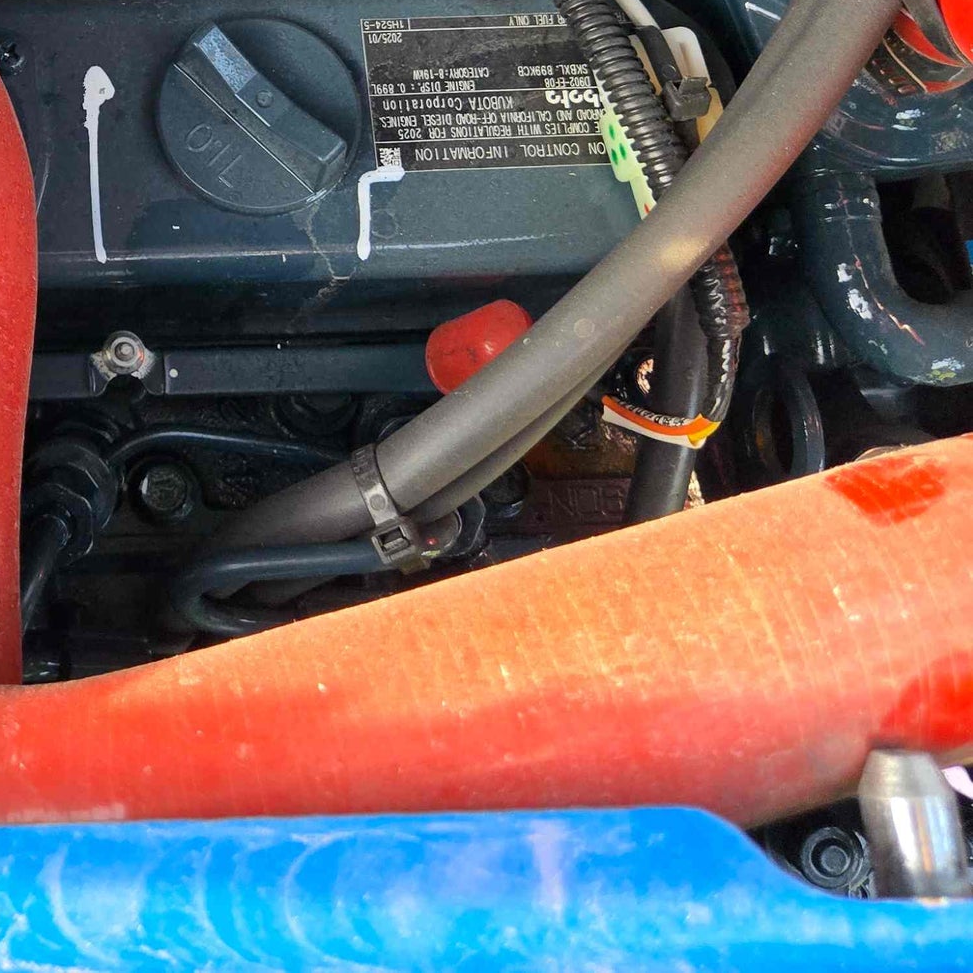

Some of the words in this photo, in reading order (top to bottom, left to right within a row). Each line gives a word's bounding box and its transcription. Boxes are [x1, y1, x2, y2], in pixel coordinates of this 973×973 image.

[364, 20, 405, 30] 1H524-5
[509, 16, 529, 26] ONLY
[532, 15, 554, 25] FUEL
[368, 33, 402, 43] 2025/01
[445, 80, 475, 90] ENGINE
[544, 76, 590, 88] D902-EF08
[382, 97, 462, 113] Corporation
[468, 96, 513, 110] KUBOTA
[421, 114, 451, 126] DIESEL
[456, 113, 496, 125] OFF-ROAD
[500, 111, 551, 124] CALIFORNIA
[556, 110, 572, 122] AND
[398, 128, 422, 139] 2025
[428, 127, 446, 138] FOR
[451, 125, 511, 137] REGULATIONS
[517, 124, 541, 136] WITH
[545, 122, 589, 134] COMPLIES
[415, 145, 508, 161] INFORMATION
[519, 142, 579, 156] CONTROL
